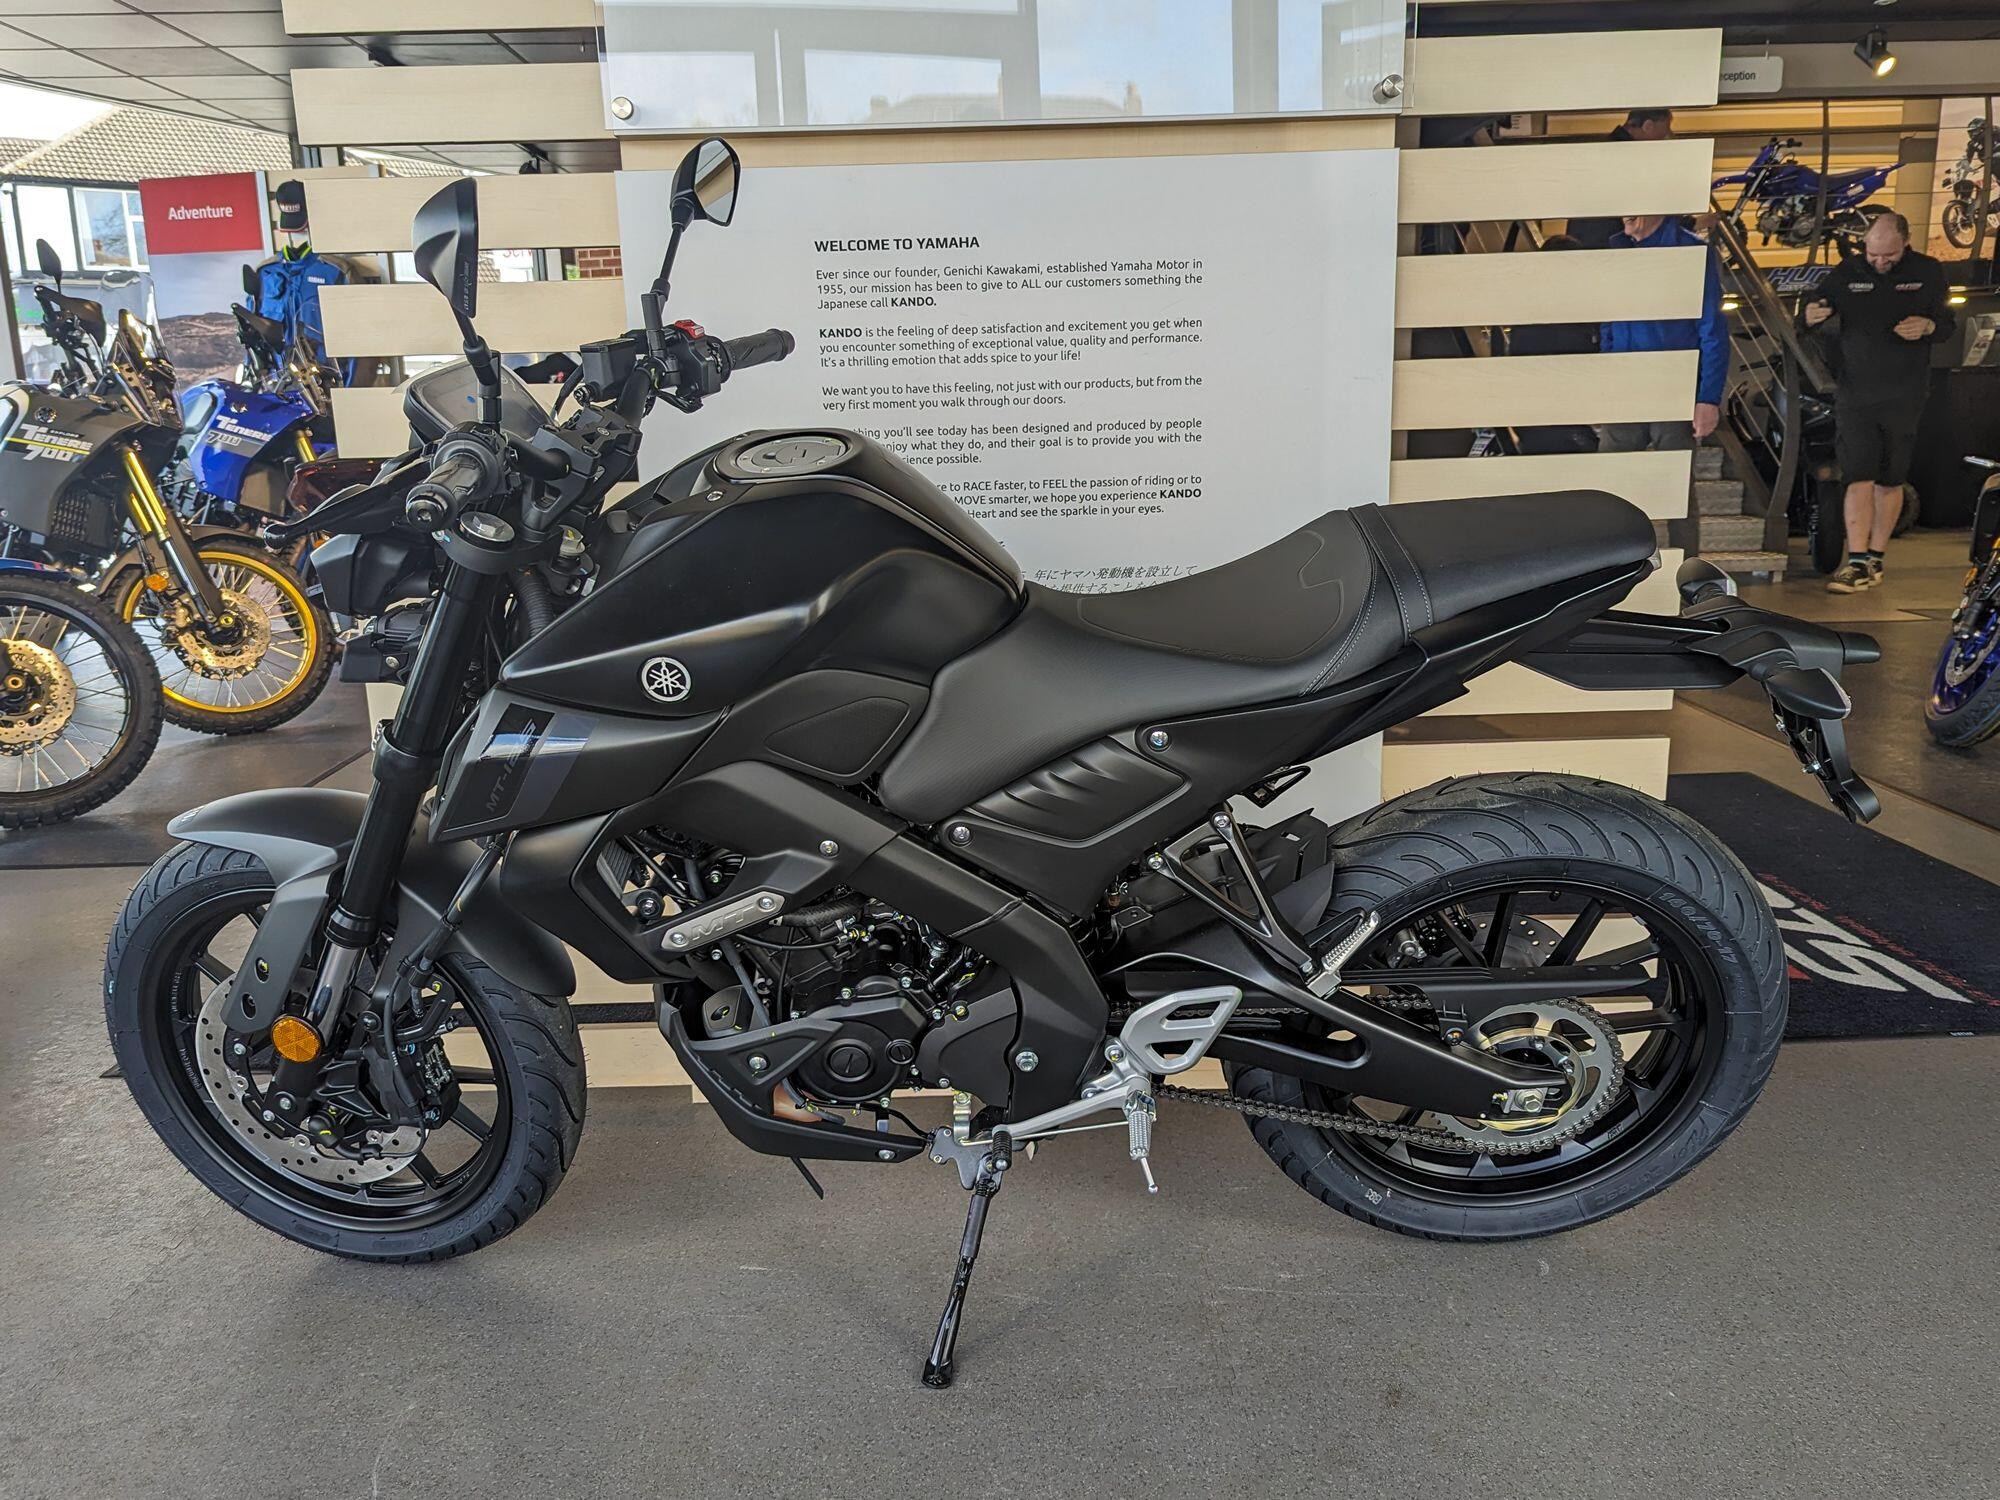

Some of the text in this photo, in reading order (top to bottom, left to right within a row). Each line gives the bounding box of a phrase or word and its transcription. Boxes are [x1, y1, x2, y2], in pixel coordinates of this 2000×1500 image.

[168, 205, 233, 220] Adventure
[814, 236, 980, 252] WELCOME TO YAMAHA
[816, 258, 1202, 280] Ever since our founder, Genichi Kawakami, established Yamaha Motor in
[817, 273, 1203, 296] 1955, our mission has been to give to ALL our customers something the
[817, 296, 936, 311] Japanese call KANDO.
[819, 317, 1202, 338] KANDO is the feeling of deep satisfaction and excitement you get when
[819, 332, 1202, 355] you encounter something of exceptional value, quality and performance.
[839, 359, 845, 367] a
[848, 355, 889, 368] thrilling
[892, 354, 936, 365] emotion
[938, 353, 961, 364] that
[963, 352, 988, 364] adds
[990, 352, 1018, 365] spice
[1020, 352, 1032, 362] to
[1034, 353, 1058, 364] your
[1060, 350, 1080, 360] life!
[822, 375, 1202, 397] We want you to have this feeling, not just with our products, but from the
[822, 394, 1066, 412] very first moment you walk through our doors.
[916, 428, 934, 436] see
[937, 425, 967, 437] today
[971, 424, 989, 435] has
[992, 424, 1018, 434] been
[1022, 422, 1070, 435] designed
[1073, 421, 1092, 432] and
[1096, 419, 1146, 433] produced
[1150, 419, 1162, 431] by
[1166, 417, 1202, 431] people
[207, 431, 241, 446] 700
[910, 440, 938, 450] what
[941, 439, 965, 451] they
[967, 439, 984, 450] do,
[987, 438, 1007, 448] and
[1010, 437, 1036, 448] their
[1039, 436, 1062, 449] goal
[1065, 436, 1073, 446] is
[1077, 437, 1088, 446] to
[1092, 434, 1131, 447] provide
[1134, 436, 1154, 446] you
[1157, 432, 1180, 443] with
[1184, 432, 1202, 442] the
[23, 444, 74, 462] 700
[936, 453, 982, 466] possible.
[949, 483, 961, 492] to
[963, 481, 992, 491] RACE
[994, 480, 1027, 491] faster,
[1029, 480, 1040, 489] to
[1042, 479, 1068, 489] FEEL
[1070, 478, 1087, 488] the
[1090, 477, 1128, 489] passion
[1131, 475, 1143, 486] of
[1144, 475, 1174, 487] riding
[1190, 475, 1202, 484] to
[954, 488, 1201, 505] MOVE smarter, we hope you experience KANDO
[968, 505, 1164, 519] Heart and see the sparkle in your eyes.
[690, 903, 755, 941] MT
